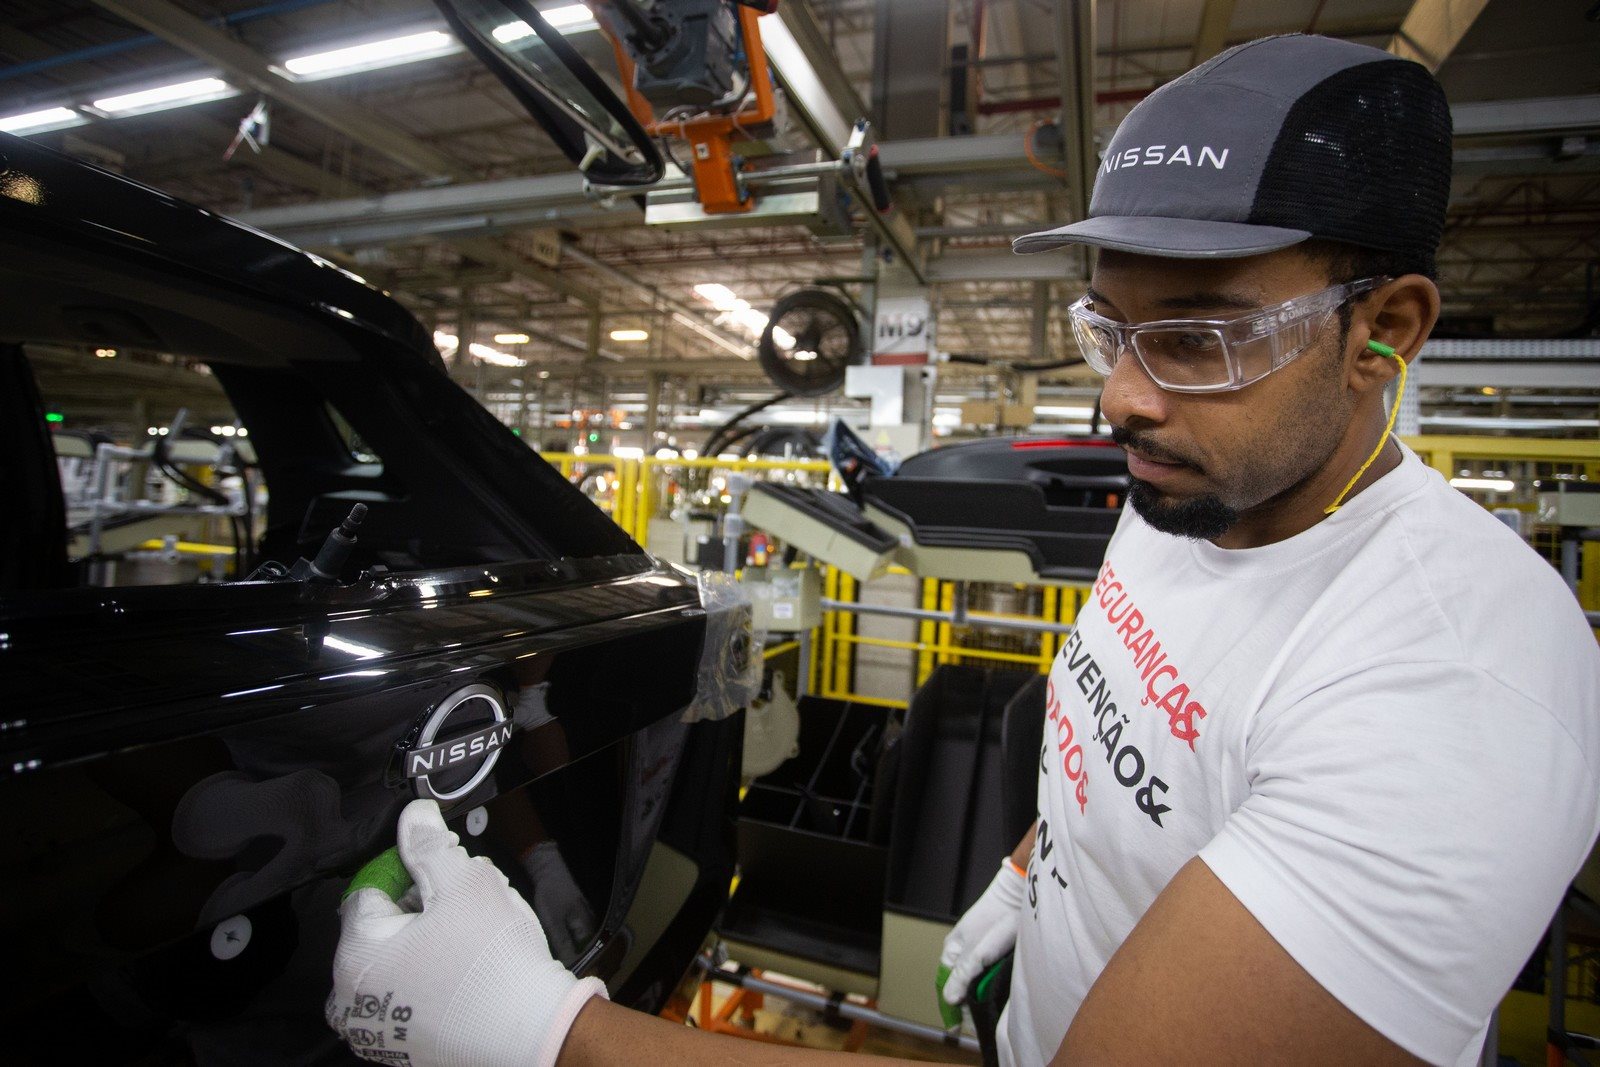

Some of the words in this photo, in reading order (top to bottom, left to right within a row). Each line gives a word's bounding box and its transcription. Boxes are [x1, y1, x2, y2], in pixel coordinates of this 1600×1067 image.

[1100, 145, 1229, 177] NISSAN
[1063, 621, 1172, 829] EVENÇÃO&
[412, 723, 513, 774] NISSAN
[391, 1005, 412, 1023] 8
[393, 1026, 407, 1041] M
